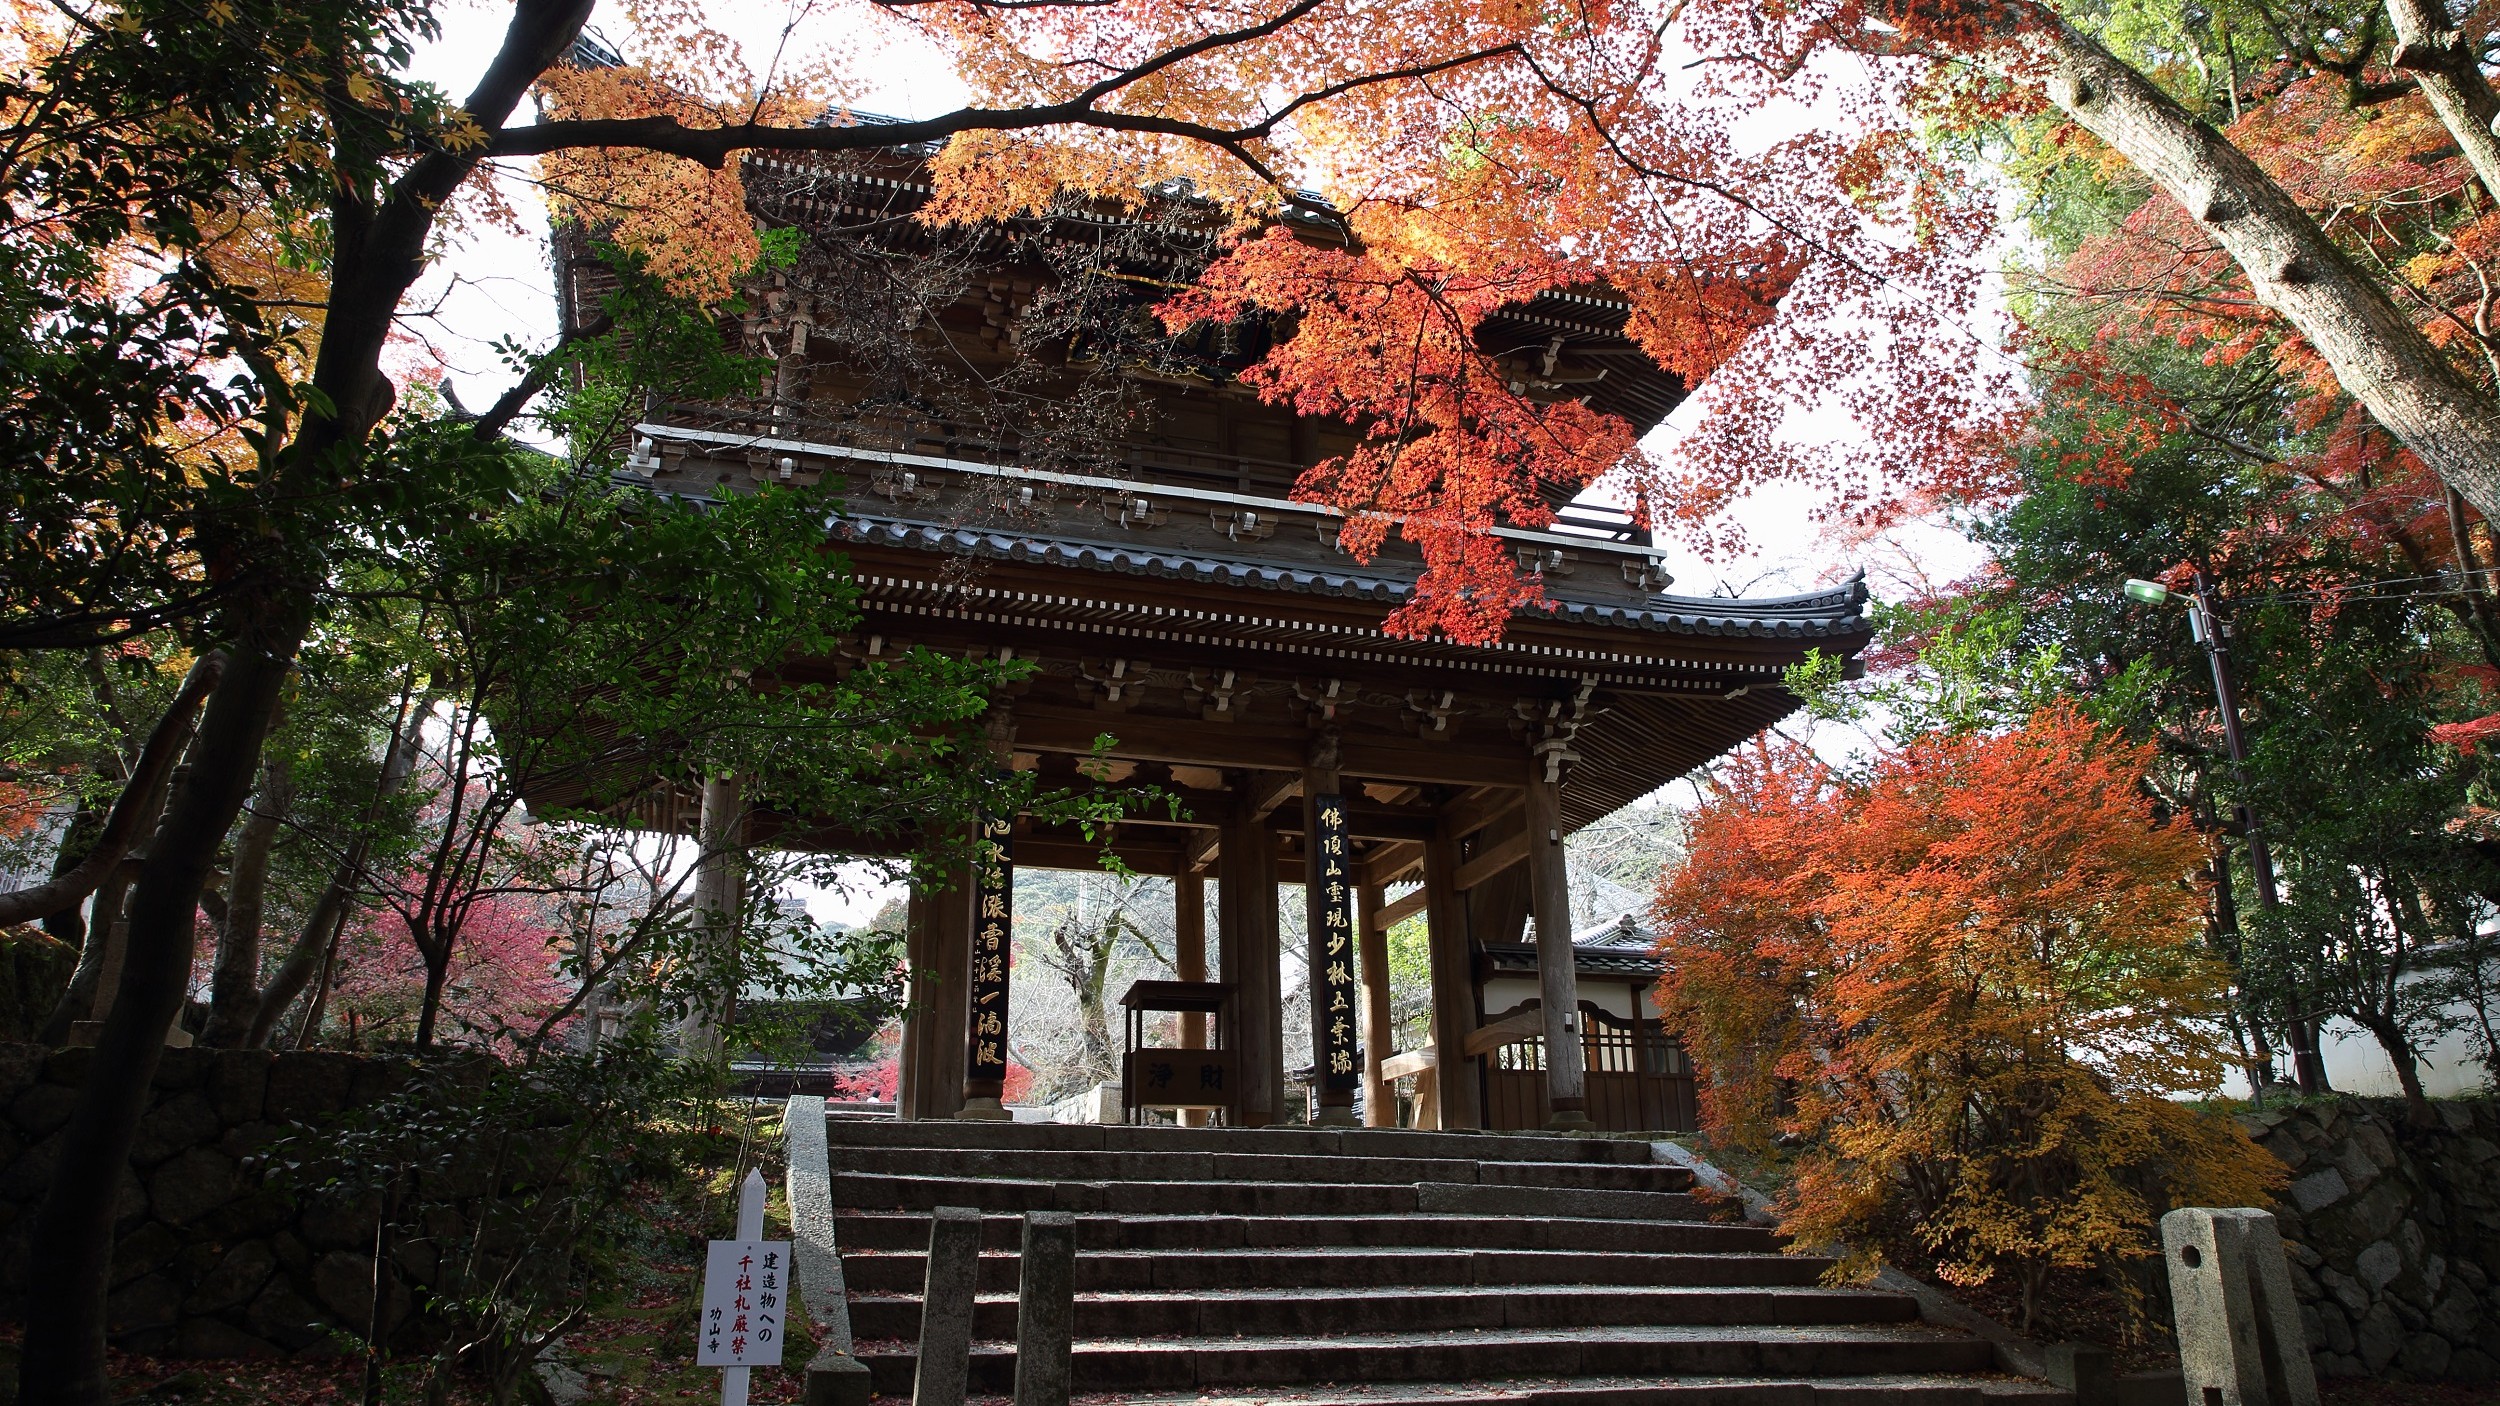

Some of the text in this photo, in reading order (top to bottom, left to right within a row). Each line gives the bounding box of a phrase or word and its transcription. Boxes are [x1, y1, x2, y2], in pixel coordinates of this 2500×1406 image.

[707, 1306, 722, 1354] 功山寺
[731, 1254, 753, 1355] 千社札厳禁
[758, 1251, 779, 1343] 建造物への
